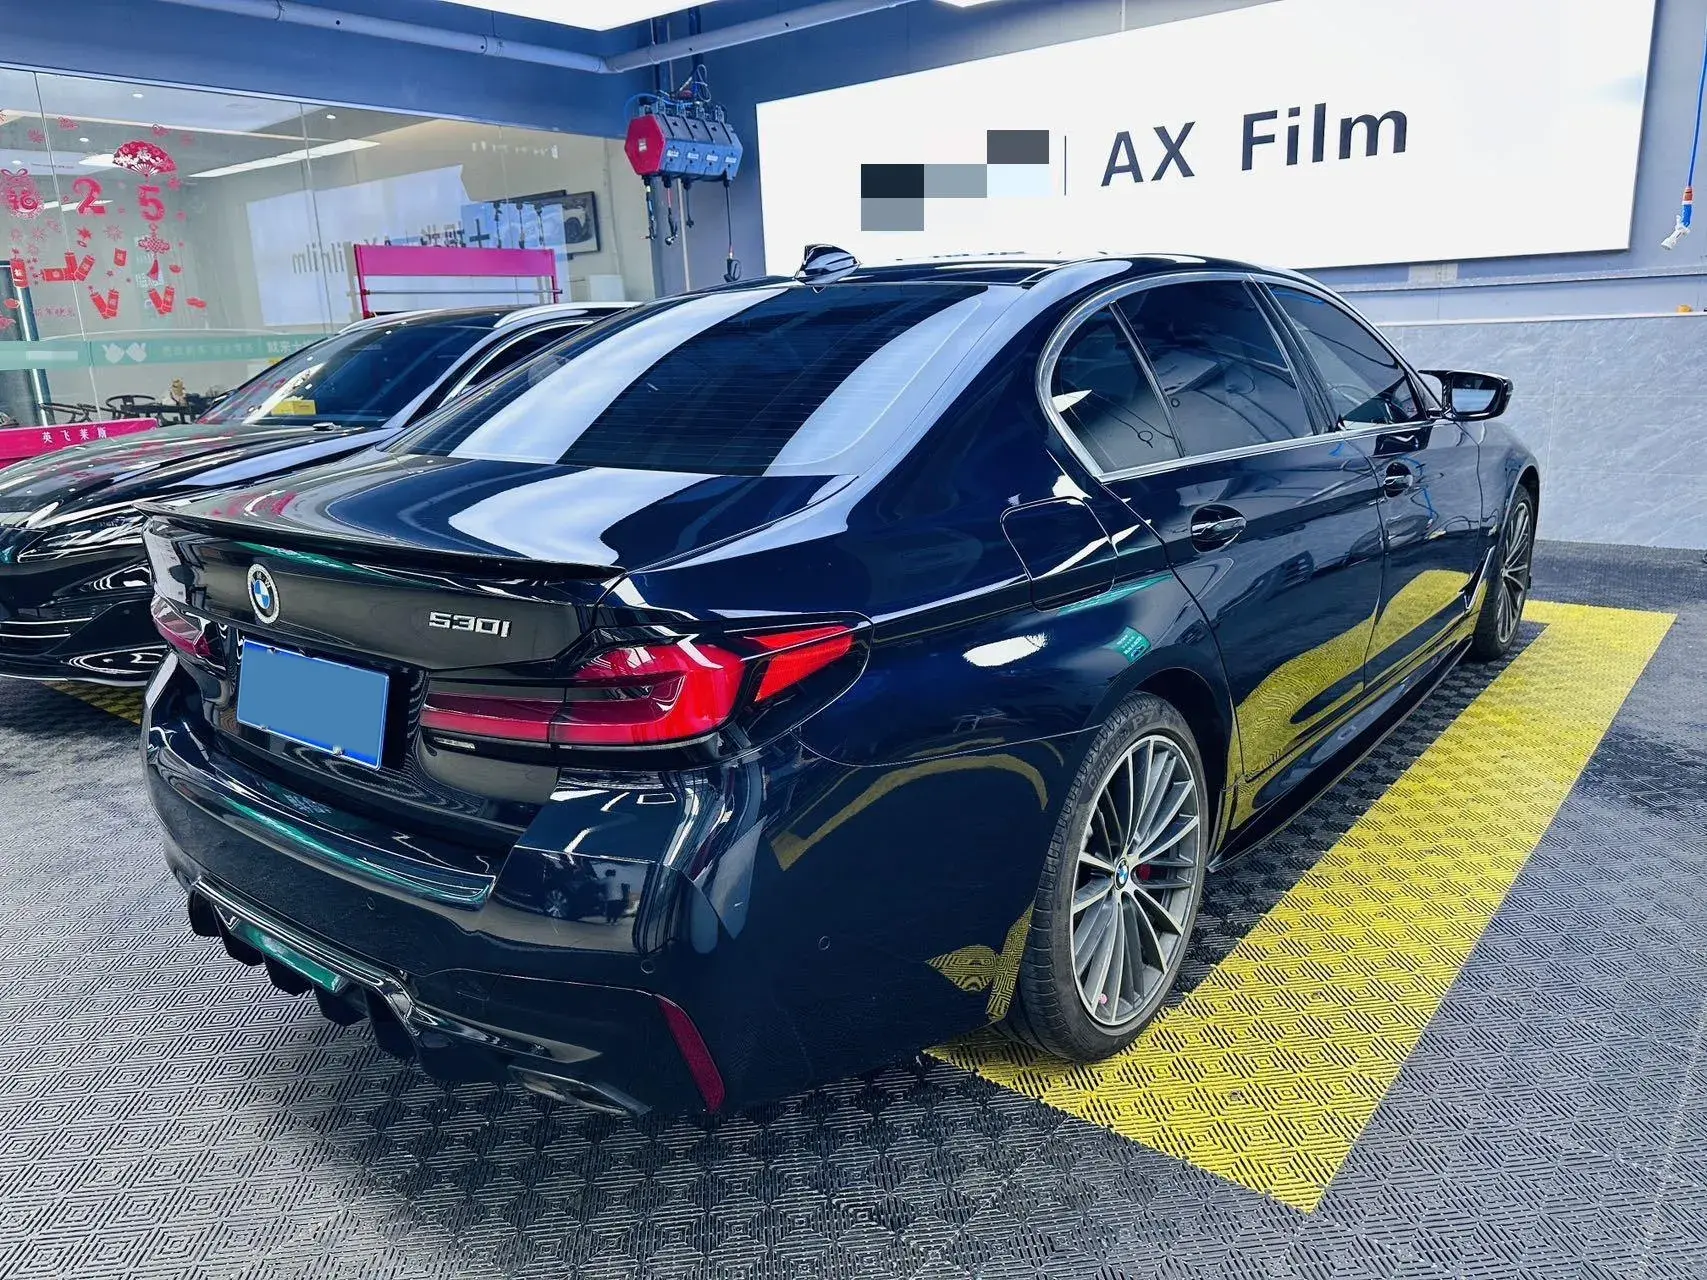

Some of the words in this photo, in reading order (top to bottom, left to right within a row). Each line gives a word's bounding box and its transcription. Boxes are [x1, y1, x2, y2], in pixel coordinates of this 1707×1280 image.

[1100, 121, 1196, 187] AX
[1241, 102, 1408, 171] Film
[72, 177, 106, 216] 2
[137, 185, 165, 222] 5
